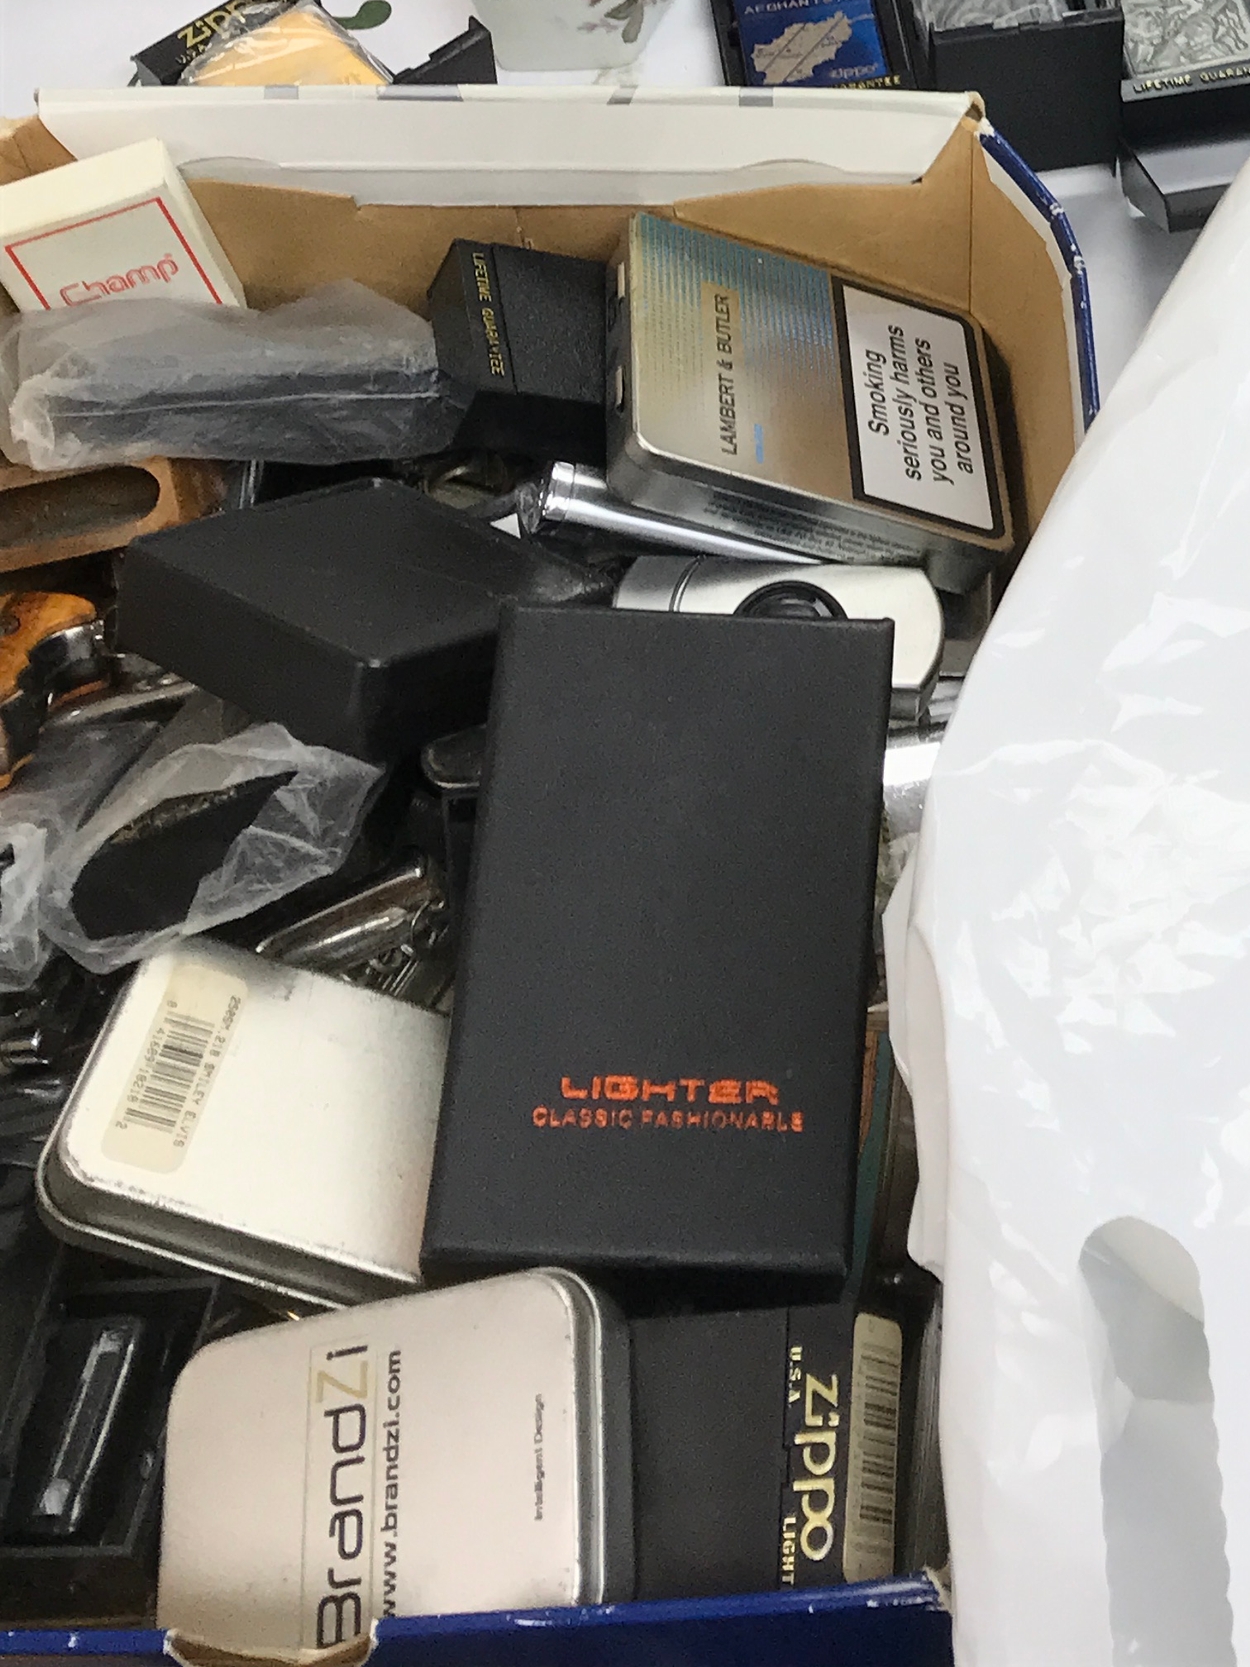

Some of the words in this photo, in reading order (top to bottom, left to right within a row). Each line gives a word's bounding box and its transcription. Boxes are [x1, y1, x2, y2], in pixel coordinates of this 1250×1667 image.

[1131, 73, 1194, 94] LIFETIME
[59, 255, 181, 306] Champ
[470, 251, 493, 304] LIFETIME
[482, 303, 505, 377] GUARANTEE
[715, 292, 731, 358] BUTLER
[720, 355, 734, 374] &
[887, 324, 905, 390] harms
[916, 337, 934, 404] others
[947, 361, 963, 402] you
[718, 371, 738, 456] LAMBERT
[866, 347, 889, 437] Smoking
[927, 404, 944, 443] and
[895, 392, 923, 483] seriously
[931, 442, 955, 486] you
[953, 404, 975, 475] around
[191, 1061, 216, 1105] SMILEY
[559, 1074, 780, 1106] LIGHTER
[174, 1109, 197, 1148] ELVIS
[531, 1105, 634, 1131] CLASSIC
[640, 1108, 806, 1133] FASHIONABLE
[533, 1392, 544, 1443] Design
[311, 1343, 370, 1651] BrandZi
[379, 1350, 404, 1618] www.brandzi.com
[533, 1447, 544, 1522] Intelligent
[791, 1373, 840, 1562] Zippo
